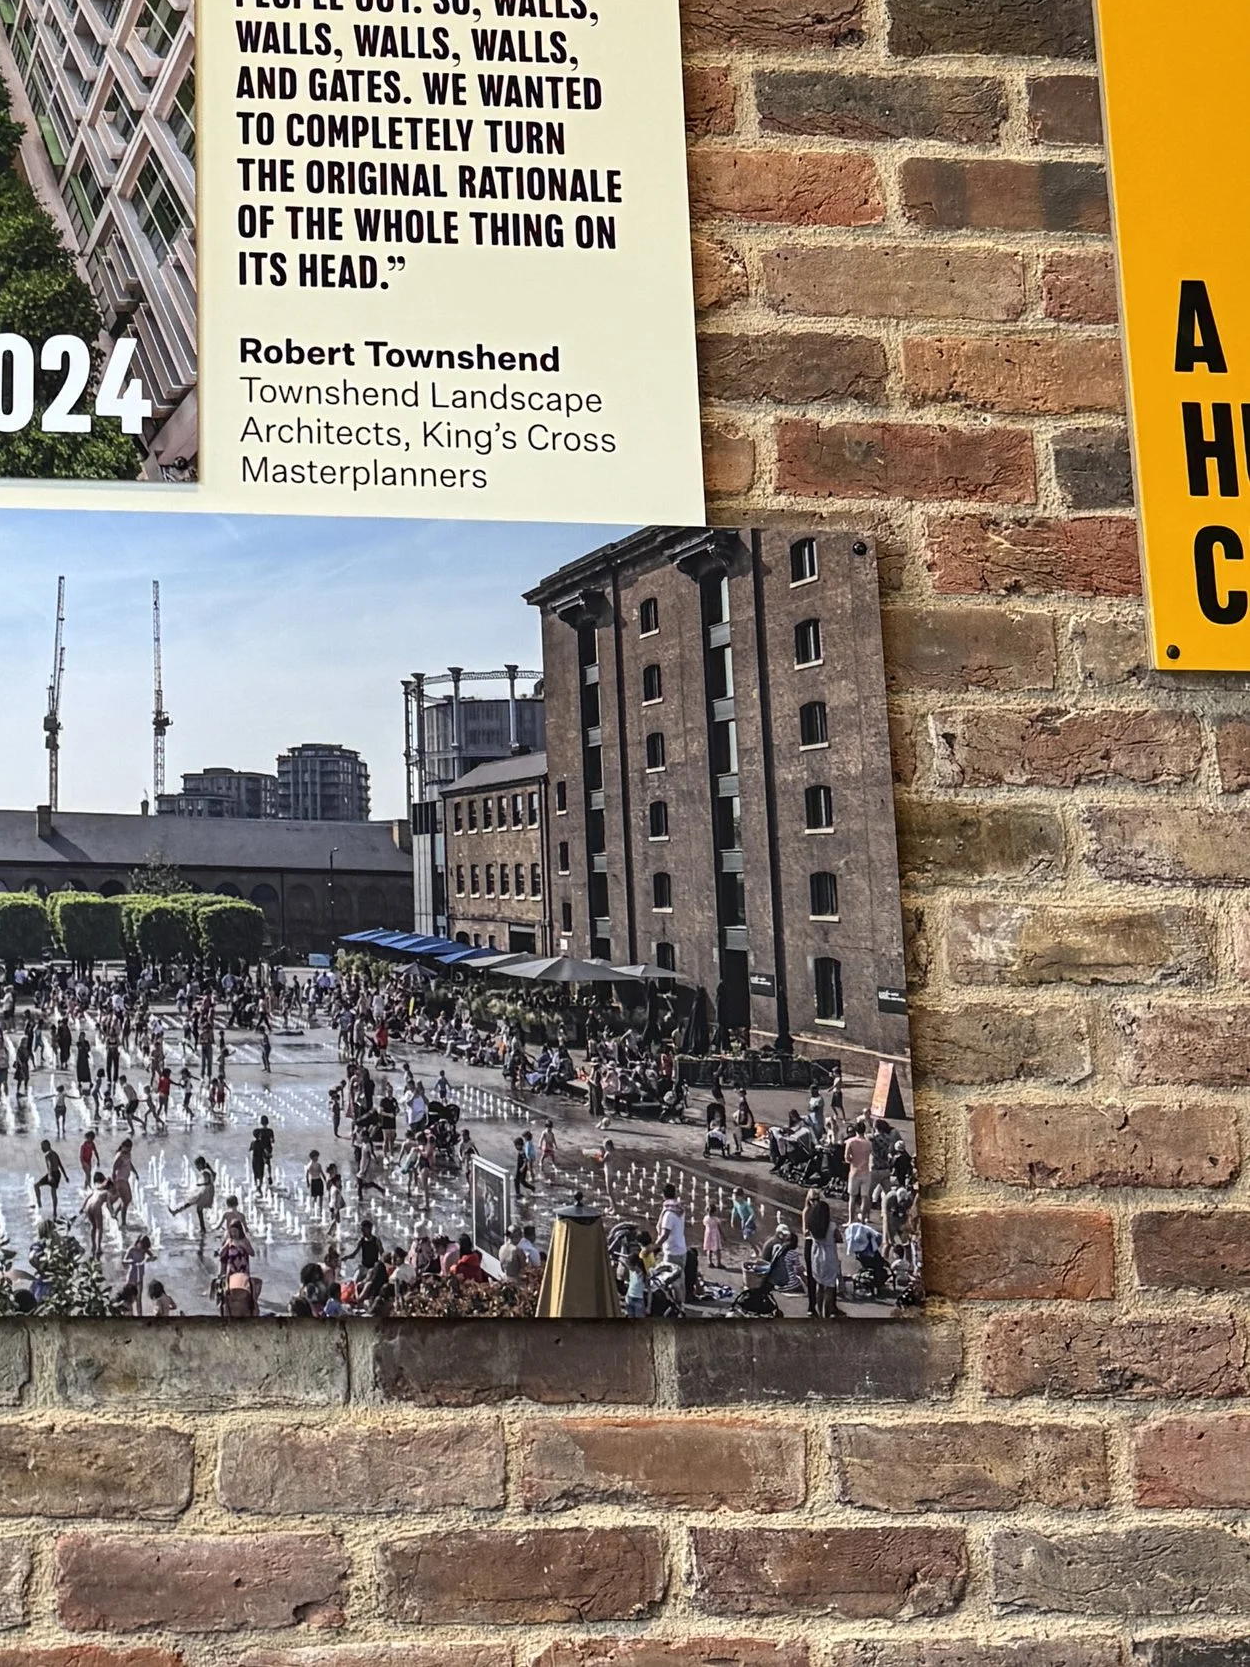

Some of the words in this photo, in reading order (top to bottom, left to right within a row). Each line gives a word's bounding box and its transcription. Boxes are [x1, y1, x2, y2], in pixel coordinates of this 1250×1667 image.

[235, 20, 343, 64] WALLS,
[353, 24, 461, 68] WALLS,
[470, 28, 579, 72] WALLS,
[235, 65, 298, 100] AND
[308, 67, 412, 105] GATES.
[422, 71, 467, 106] WE
[477, 73, 602, 111] WANTED
[235, 111, 275, 146] TO
[286, 112, 474, 152] COMPLETELY
[483, 119, 565, 156] TURN
[236, 157, 295, 193] THE
[306, 159, 448, 198] ORIGINAL
[458, 164, 623, 204] RATIONALE
[237, 204, 275, 239] OF
[284, 205, 344, 241] THE
[353, 207, 459, 245] WHOLE
[468, 211, 565, 248] THING
[575, 214, 617, 250] ON
[238, 251, 288, 287] ITS
[298, 253, 406, 290] HEAD.”
[1174, 279, 1228, 374] A
[240, 337, 356, 367] Robert
[364, 340, 560, 373] Townshend
[239, 376, 419, 408] Townshend
[431, 381, 602, 418] Landscape
[239, 416, 410, 452] Architects,
[422, 420, 517, 456] King’s
[527, 423, 616, 453] Cross
[242, 455, 488, 492] Masterplanners
